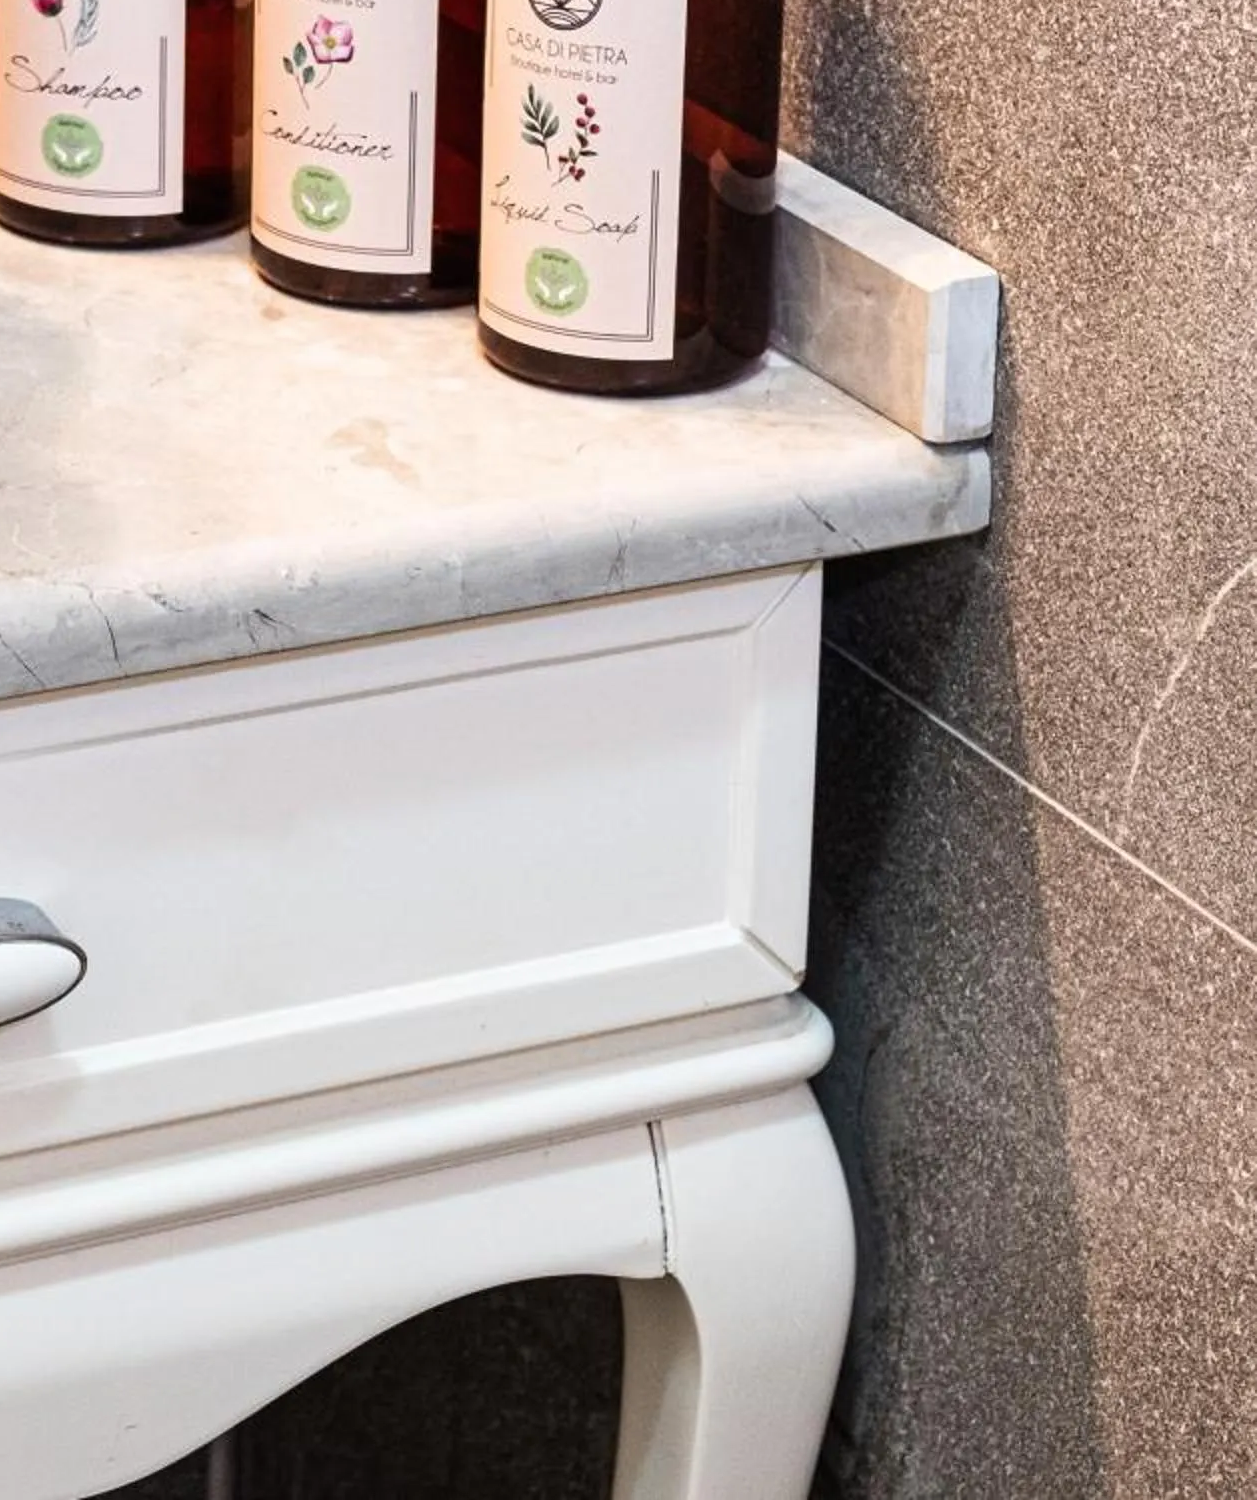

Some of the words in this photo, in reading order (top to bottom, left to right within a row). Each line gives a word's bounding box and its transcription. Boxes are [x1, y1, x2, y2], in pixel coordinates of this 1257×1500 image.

[506, 27, 543, 53] CASA
[547, 39, 564, 58] DI
[568, 42, 628, 66] PIETRA
[3, 54, 143, 109] Shampoo
[259, 109, 394, 161] Conditioner
[490, 175, 550, 224] Liquid
[554, 203, 640, 243] Soap
